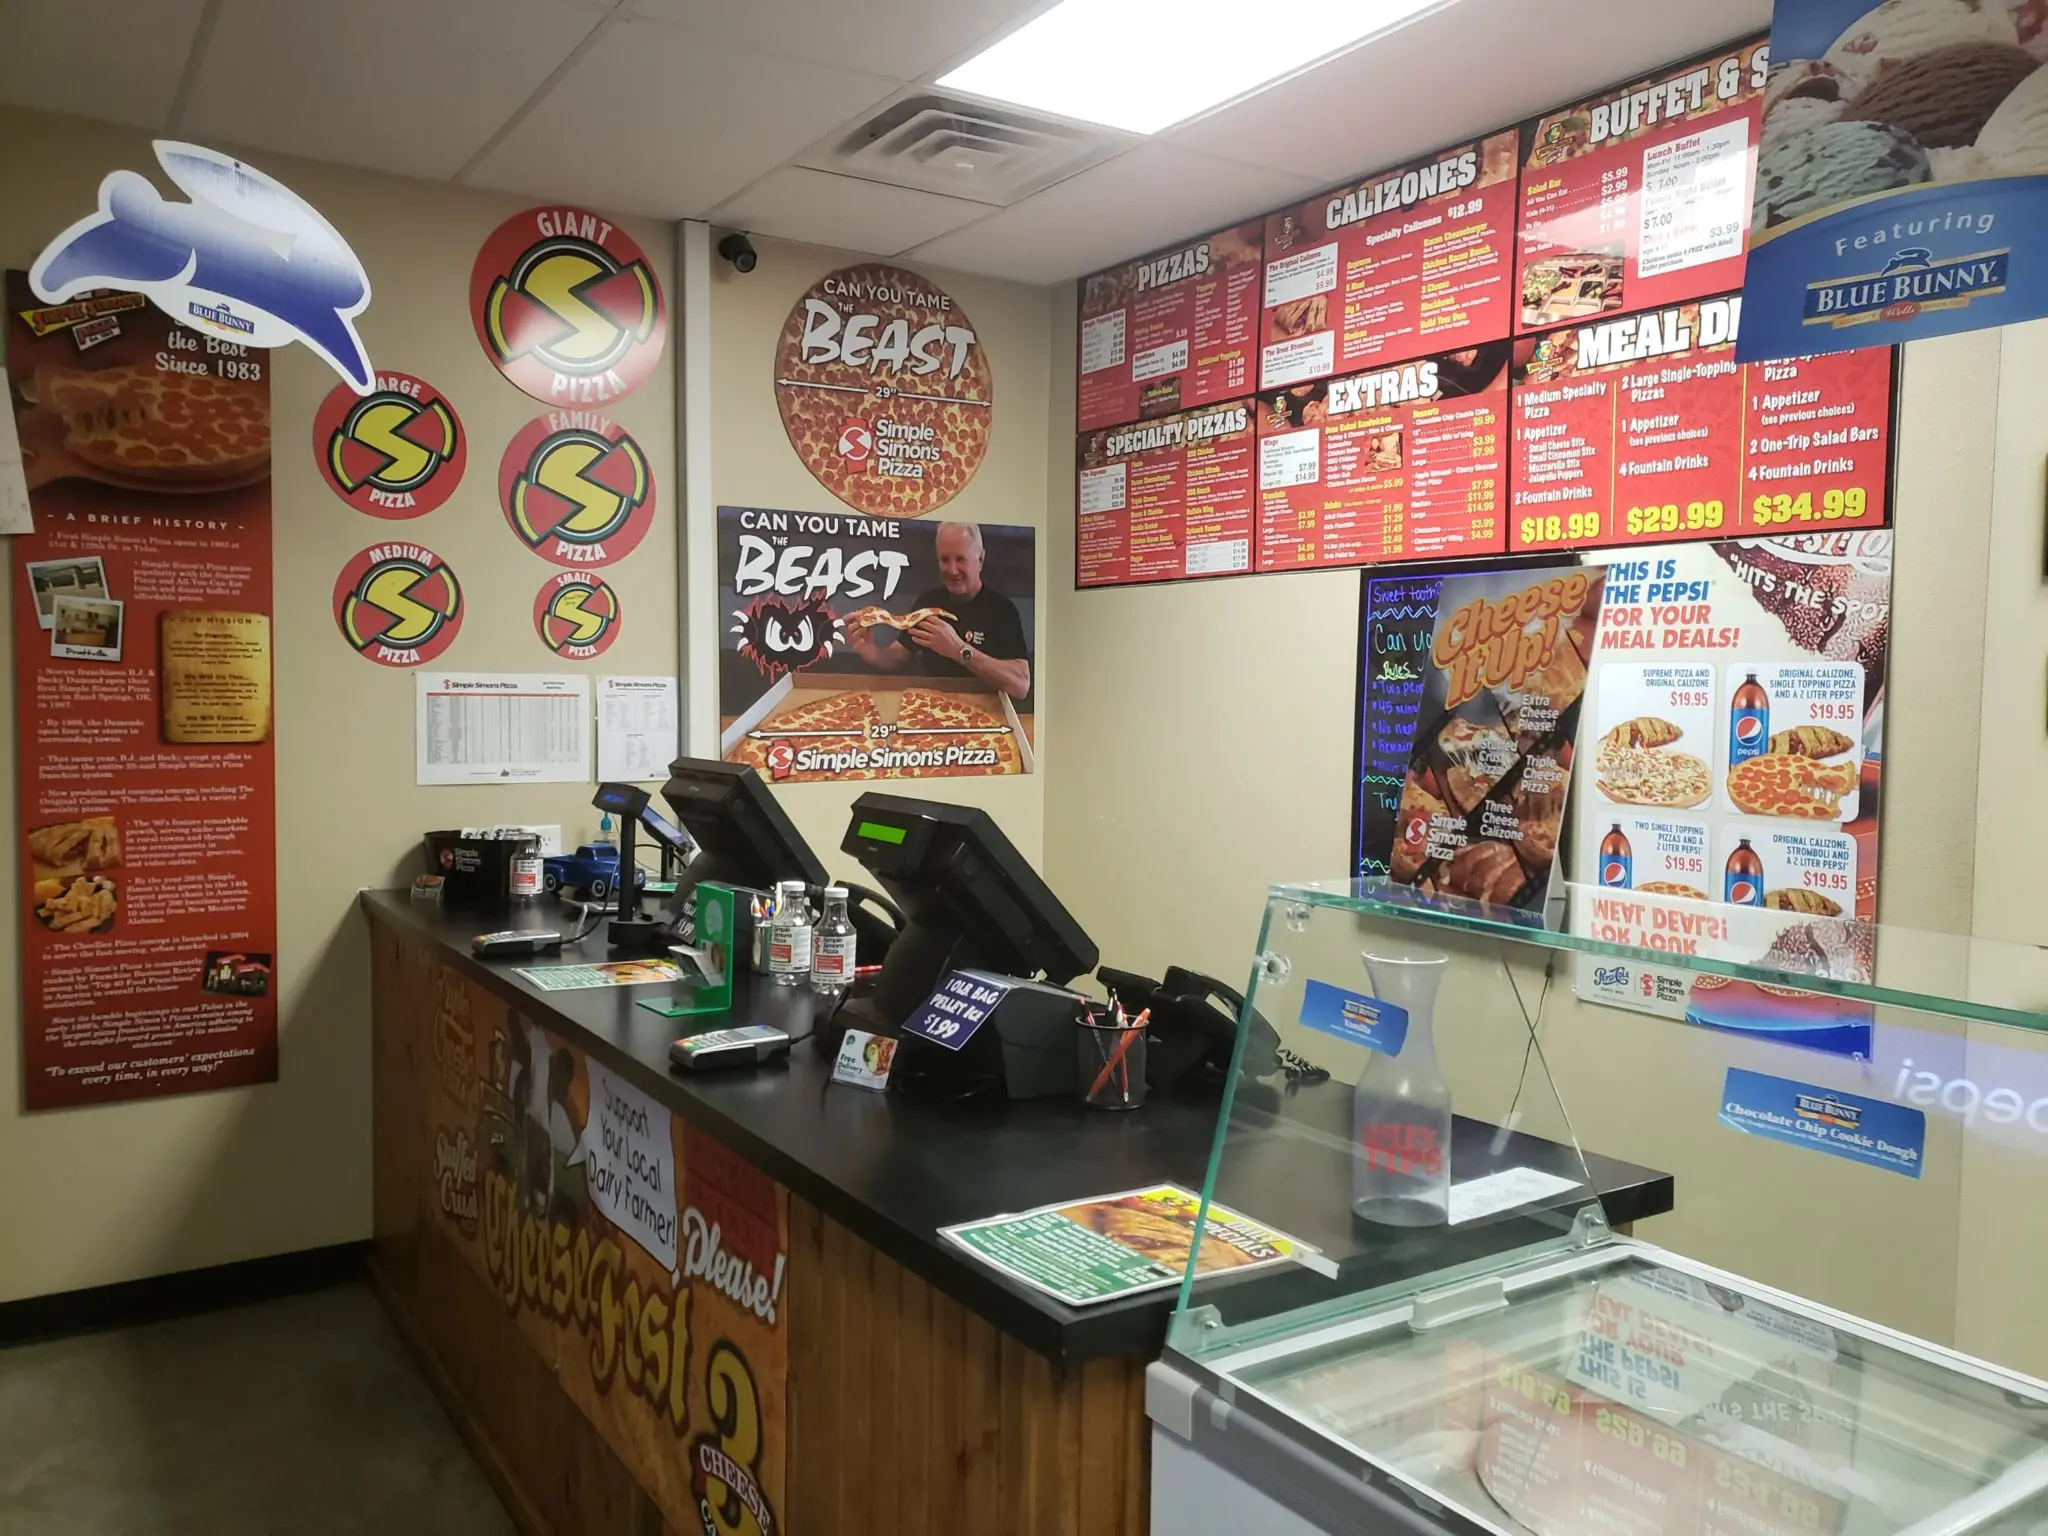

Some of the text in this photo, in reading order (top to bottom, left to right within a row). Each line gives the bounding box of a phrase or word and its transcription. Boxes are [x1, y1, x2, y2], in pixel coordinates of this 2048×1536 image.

[1590, 67, 1709, 145] BUFFET
[1717, 57, 1740, 100] &
[1326, 151, 1477, 230] CALIZONES
[1447, 199, 1483, 219] $12.99
[537, 211, 613, 246] GIANT
[1366, 228, 1401, 246] Specialty
[1403, 216, 1442, 235] Calizones
[1836, 211, 1995, 257] Featuring
[1137, 243, 1209, 292] PIZZAS
[824, 279, 950, 311] CAN YOU TAME
[1816, 281, 1887, 313] BLUE
[193, 303, 254, 332] BLUE BUNNY
[838, 302, 854, 313] THE
[168, 331, 248, 357] the Best
[801, 299, 976, 380] BEAST
[1577, 305, 1692, 370] MEAL
[155, 352, 261, 381] Since 1983
[1621, 360, 1737, 390] 2 Large Single-Topping
[1764, 365, 1797, 382] Pizza
[373, 376, 422, 399] ARGE
[552, 369, 627, 402] PIZZA
[1328, 362, 1438, 415] EXTRAS
[1516, 381, 1607, 407] 1 Medium Specialty
[1631, 387, 1665, 403] Pizzas
[1752, 389, 1821, 412] 1 Appetizer
[548, 411, 611, 434] FAMILY
[1524, 406, 1550, 420] Pizza
[1621, 414, 1679, 433] 1 Appetizer
[876, 419, 934, 441] Simple
[1106, 407, 1247, 457] SPECIALTY PIZZAS
[1516, 424, 1567, 442] 1 Appetizer
[1749, 426, 1879, 454] 2 One-Trip Salad Bars
[876, 439, 940, 461] Simon's
[878, 458, 923, 478] Pizza
[1619, 453, 1709, 476] 4 Fountain Drinks
[1748, 457, 1854, 481] 4 Fountain Drinks
[369, 489, 416, 508] PIZZA
[1515, 486, 1593, 505] 2 Fountain Drinks
[1753, 487, 1866, 526] $34.99
[66, 512, 229, 530] A BRIEF HISTORY
[740, 511, 900, 539] CAN YOU TAME
[1521, 511, 1600, 544] $18.99
[1627, 500, 1724, 536] $29.99
[556, 541, 607, 562] PIZZA
[772, 536, 788, 546] THE
[368, 545, 433, 566] MEDIUM
[735, 534, 910, 601] BEAST
[1607, 559, 1677, 582] THIS IS
[557, 571, 591, 587] SMALL
[1605, 580, 1710, 604] THE PEPSI
[1784, 581, 1826, 608] THE
[1434, 573, 1589, 668] Cheese
[1602, 605, 1711, 627] FOR YOUR
[1374, 623, 1404, 654] Can
[1600, 627, 1740, 649] MEAL DEALS!
[377, 646, 420, 663] PIZZA
[568, 645, 597, 657] PIZZA
[1445, 655, 1486, 710] It
[1643, 669, 1710, 678] SUPREME PIZZA AND
[1645, 679, 1709, 688] ORIGINAL CALIZONE
[1769, 680, 1856, 689] SINGLE TOPPING PIZZA
[1779, 668, 1857, 679] ORIGINAL CALIZONE,
[1522, 693, 1550, 706] Extra
[1670, 690, 1708, 706] $19.95
[1519, 707, 1559, 719] Cheese
[1810, 703, 1854, 720] $19.95
[1518, 718, 1557, 732] Please!
[796, 747, 998, 773] Simple Simon's Pizza
[1525, 754, 1557, 768] Triple
[1523, 767, 1563, 781] Cheese
[1520, 779, 1550, 794] Pizza
[1484, 799, 1513, 814] Three
[1482, 812, 1519, 827] Cheese
[1479, 825, 1524, 841] Calizone
[1773, 834, 1849, 850] ORIGINAL CALIZONE,
[1787, 846, 1849, 860] STROMBOLI AND
[1665, 857, 1702, 873] $19.95
[1803, 869, 1847, 890] $19.95
[929, 993, 968, 1015] PELLET
[971, 986, 999, 1005] BAG
[924, 1013, 960, 1039] $1.99
[840, 1053, 856, 1064] Free
[82, 1074, 112, 1085] every
[146, 1068, 158, 1077] in
[160, 1064, 190, 1077] every
[602, 1078, 650, 1140] Support
[1725, 1101, 1918, 1161] Chocolate Chip Cookie Dough
[601, 1114, 662, 1193] Your Local
[588, 1148, 677, 1251] Dairy Farmer!
[683, 1207, 787, 1320] Please!
[700, 1444, 772, 1533] CHEESE
